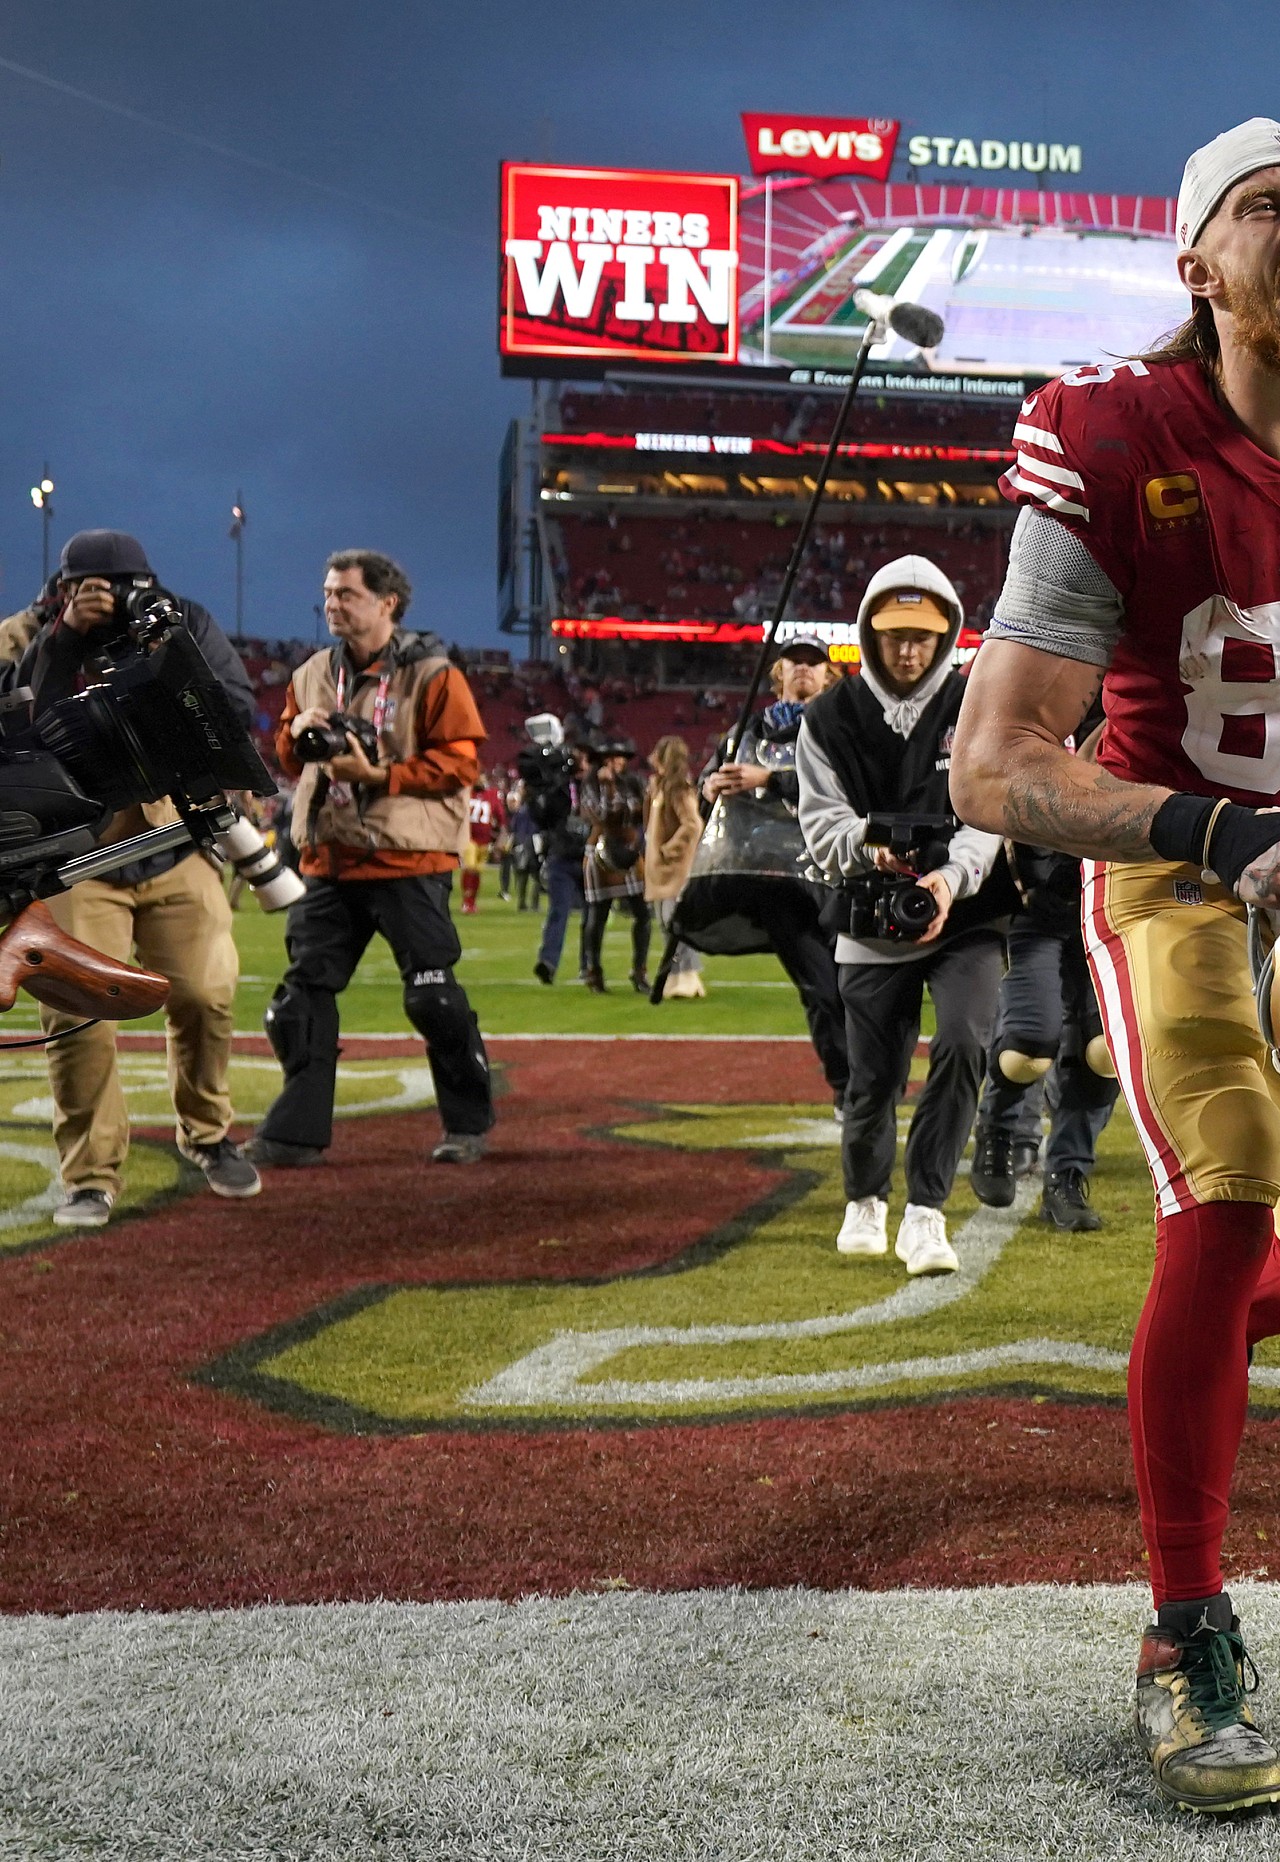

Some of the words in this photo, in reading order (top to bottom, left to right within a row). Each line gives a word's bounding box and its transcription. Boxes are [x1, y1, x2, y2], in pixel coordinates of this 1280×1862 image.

[908, 136, 1081, 172] STADIUM
[537, 205, 709, 248] NINERS
[505, 239, 738, 324] WIN
[885, 374, 961, 392] Industrial
[962, 377, 1025, 396] Internet
[634, 433, 711, 453] NINERS
[712, 436, 752, 454] WIN
[1145, 475, 1199, 519] C
